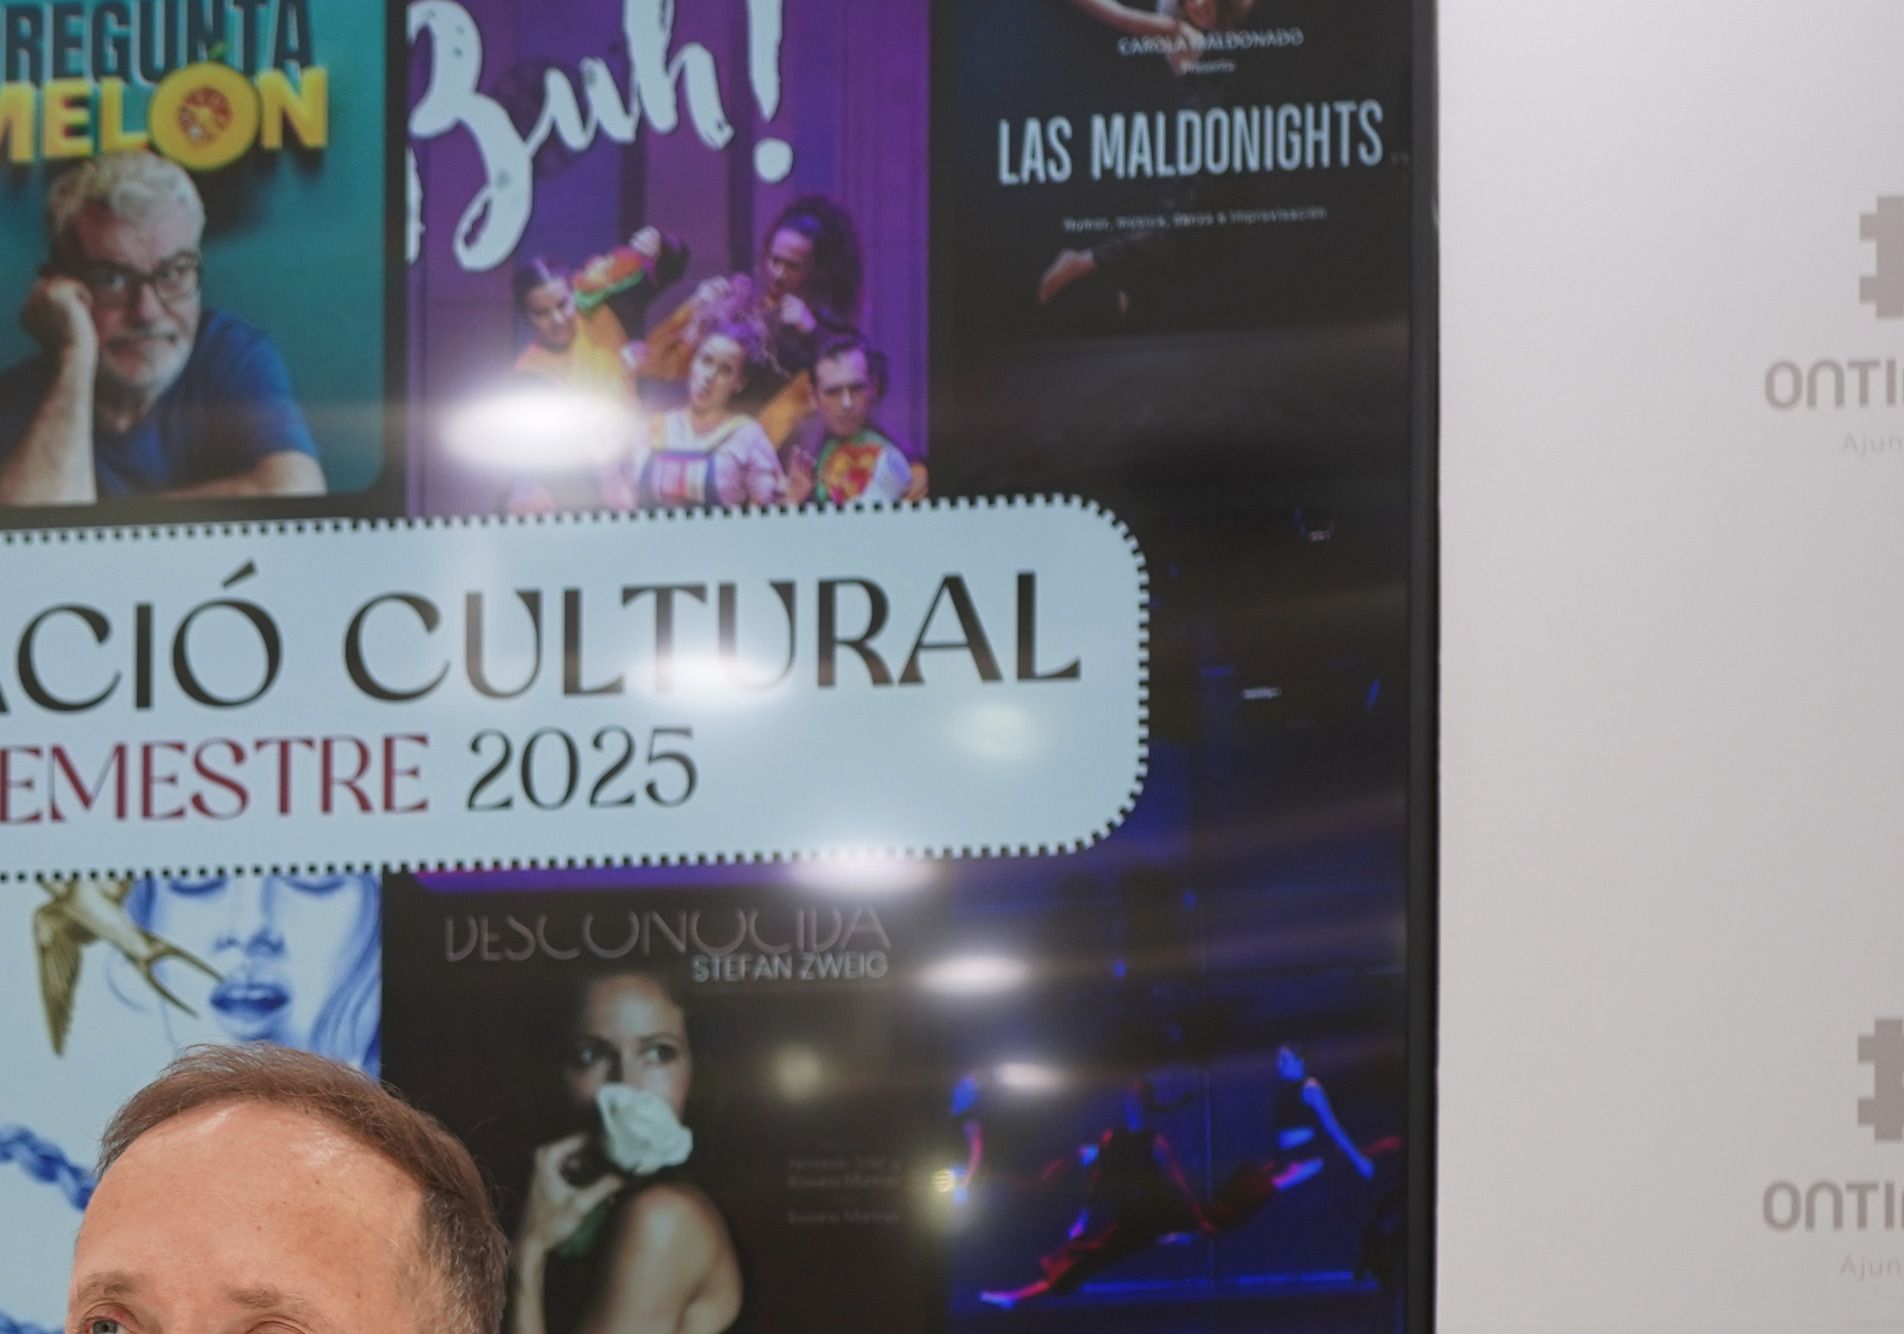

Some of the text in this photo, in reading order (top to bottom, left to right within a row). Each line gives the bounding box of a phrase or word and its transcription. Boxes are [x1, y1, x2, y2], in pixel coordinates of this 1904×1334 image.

[1190, 27, 1305, 53] MALDONADO
[998, 99, 1384, 186] LAS MALDONIGHTS
[1764, 358, 1904, 411] ONTI
[341, 569, 1084, 704] CULTURAL
[464, 724, 701, 816] 2025
[443, 903, 893, 963] DESCONOCIDA
[690, 948, 890, 983] STEFAN ZWEIG
[1762, 1180, 1904, 1232] ONTI
